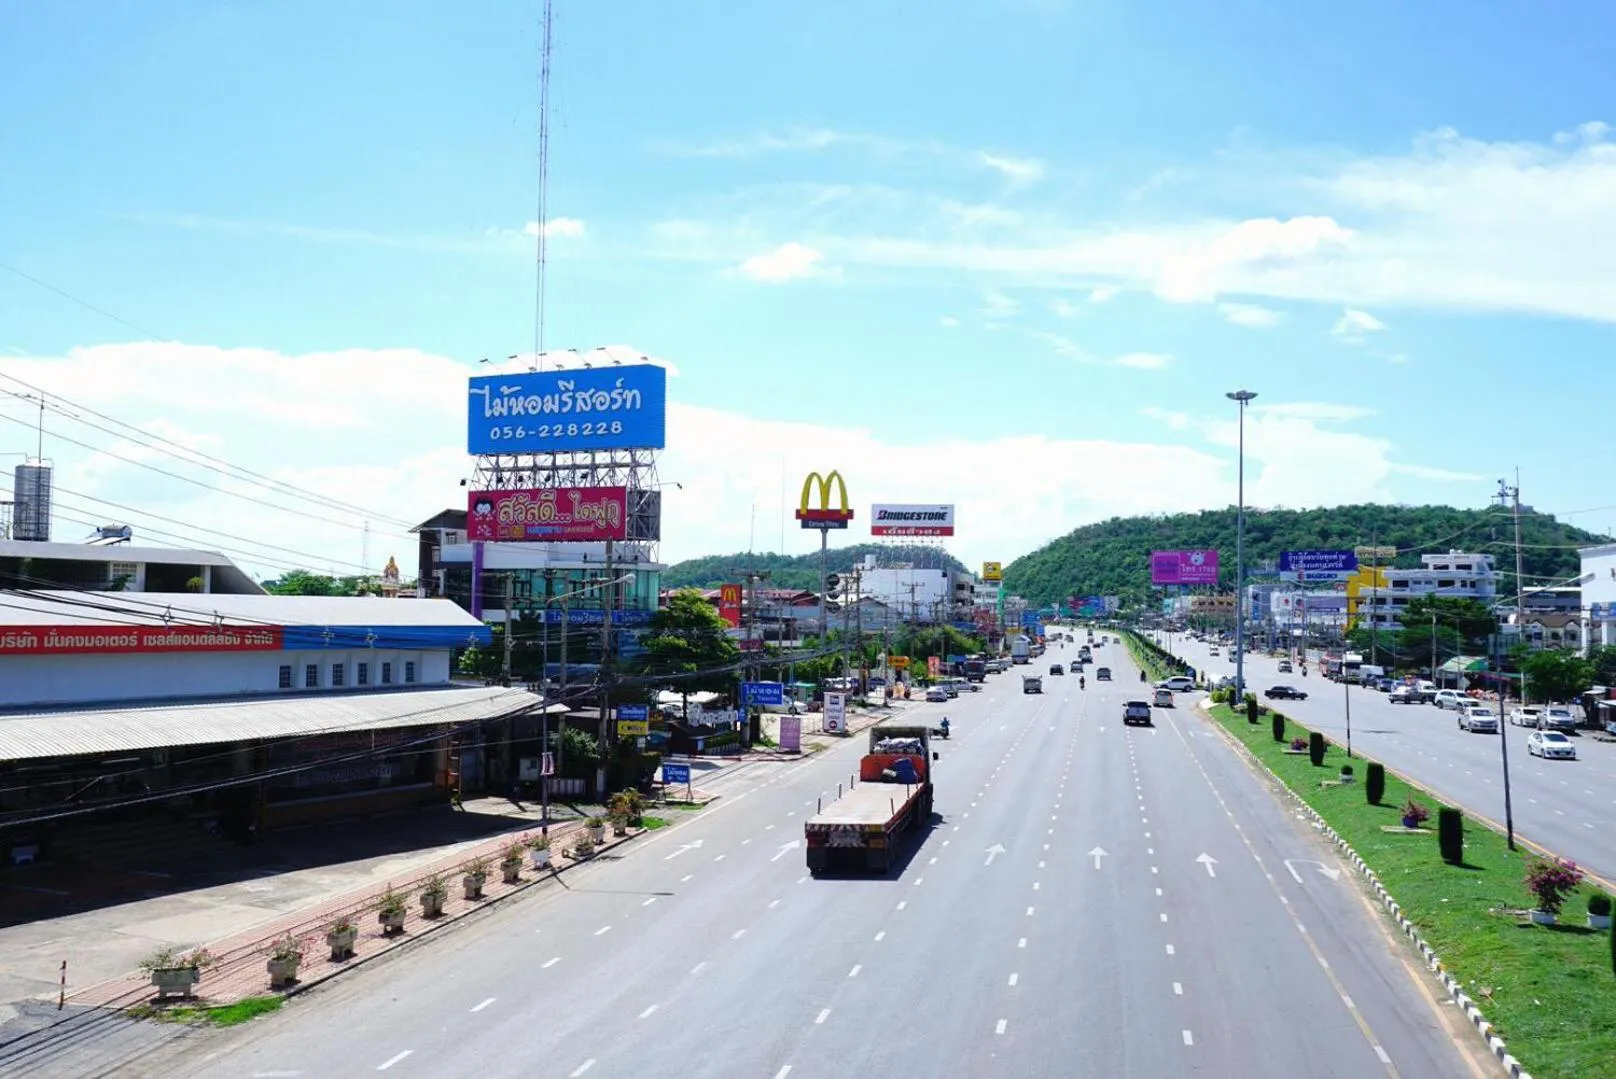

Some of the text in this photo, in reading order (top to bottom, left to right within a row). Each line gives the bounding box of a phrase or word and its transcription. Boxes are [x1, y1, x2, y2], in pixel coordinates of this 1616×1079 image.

[469, 377, 642, 418] ไม้หอมรีสอร์ท
[489, 420, 623, 440] 056-228228
[876, 509, 948, 521] BRIDGESTONE
[43, 628, 138, 647] มั่นคงมอเตอร์
